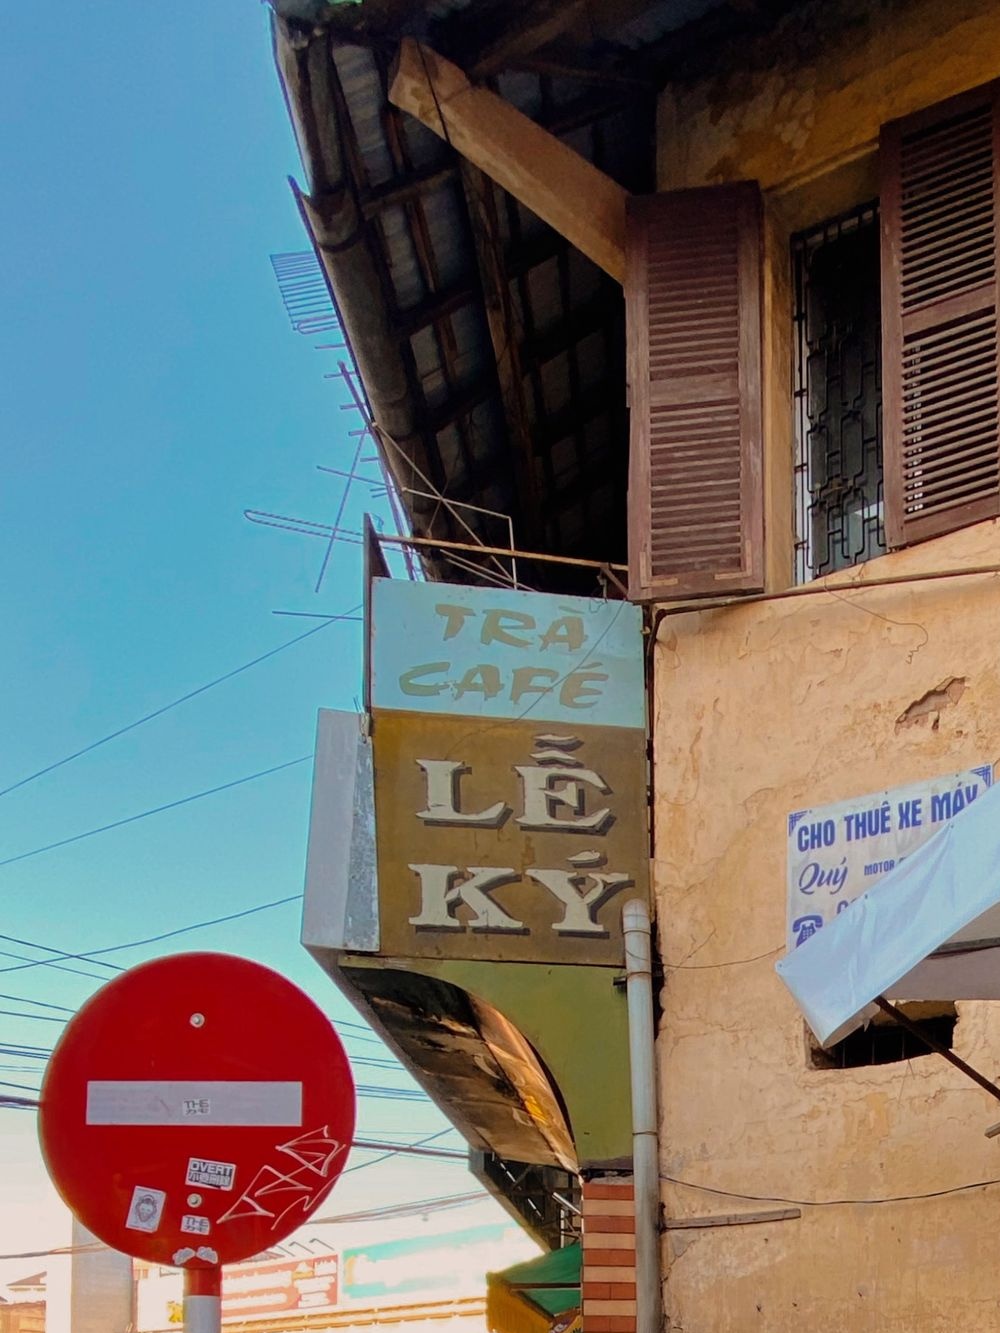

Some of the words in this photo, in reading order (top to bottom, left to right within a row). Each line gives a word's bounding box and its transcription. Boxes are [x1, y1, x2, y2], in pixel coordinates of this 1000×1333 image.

[435, 603, 590, 653] TRÀ
[399, 660, 610, 709] CAFÉ
[415, 733, 616, 836] LỄ
[797, 819, 835, 852] CHO
[844, 801, 890, 841] THUÊ
[898, 799, 922, 830] XE
[864, 859, 895, 876] MOTOR
